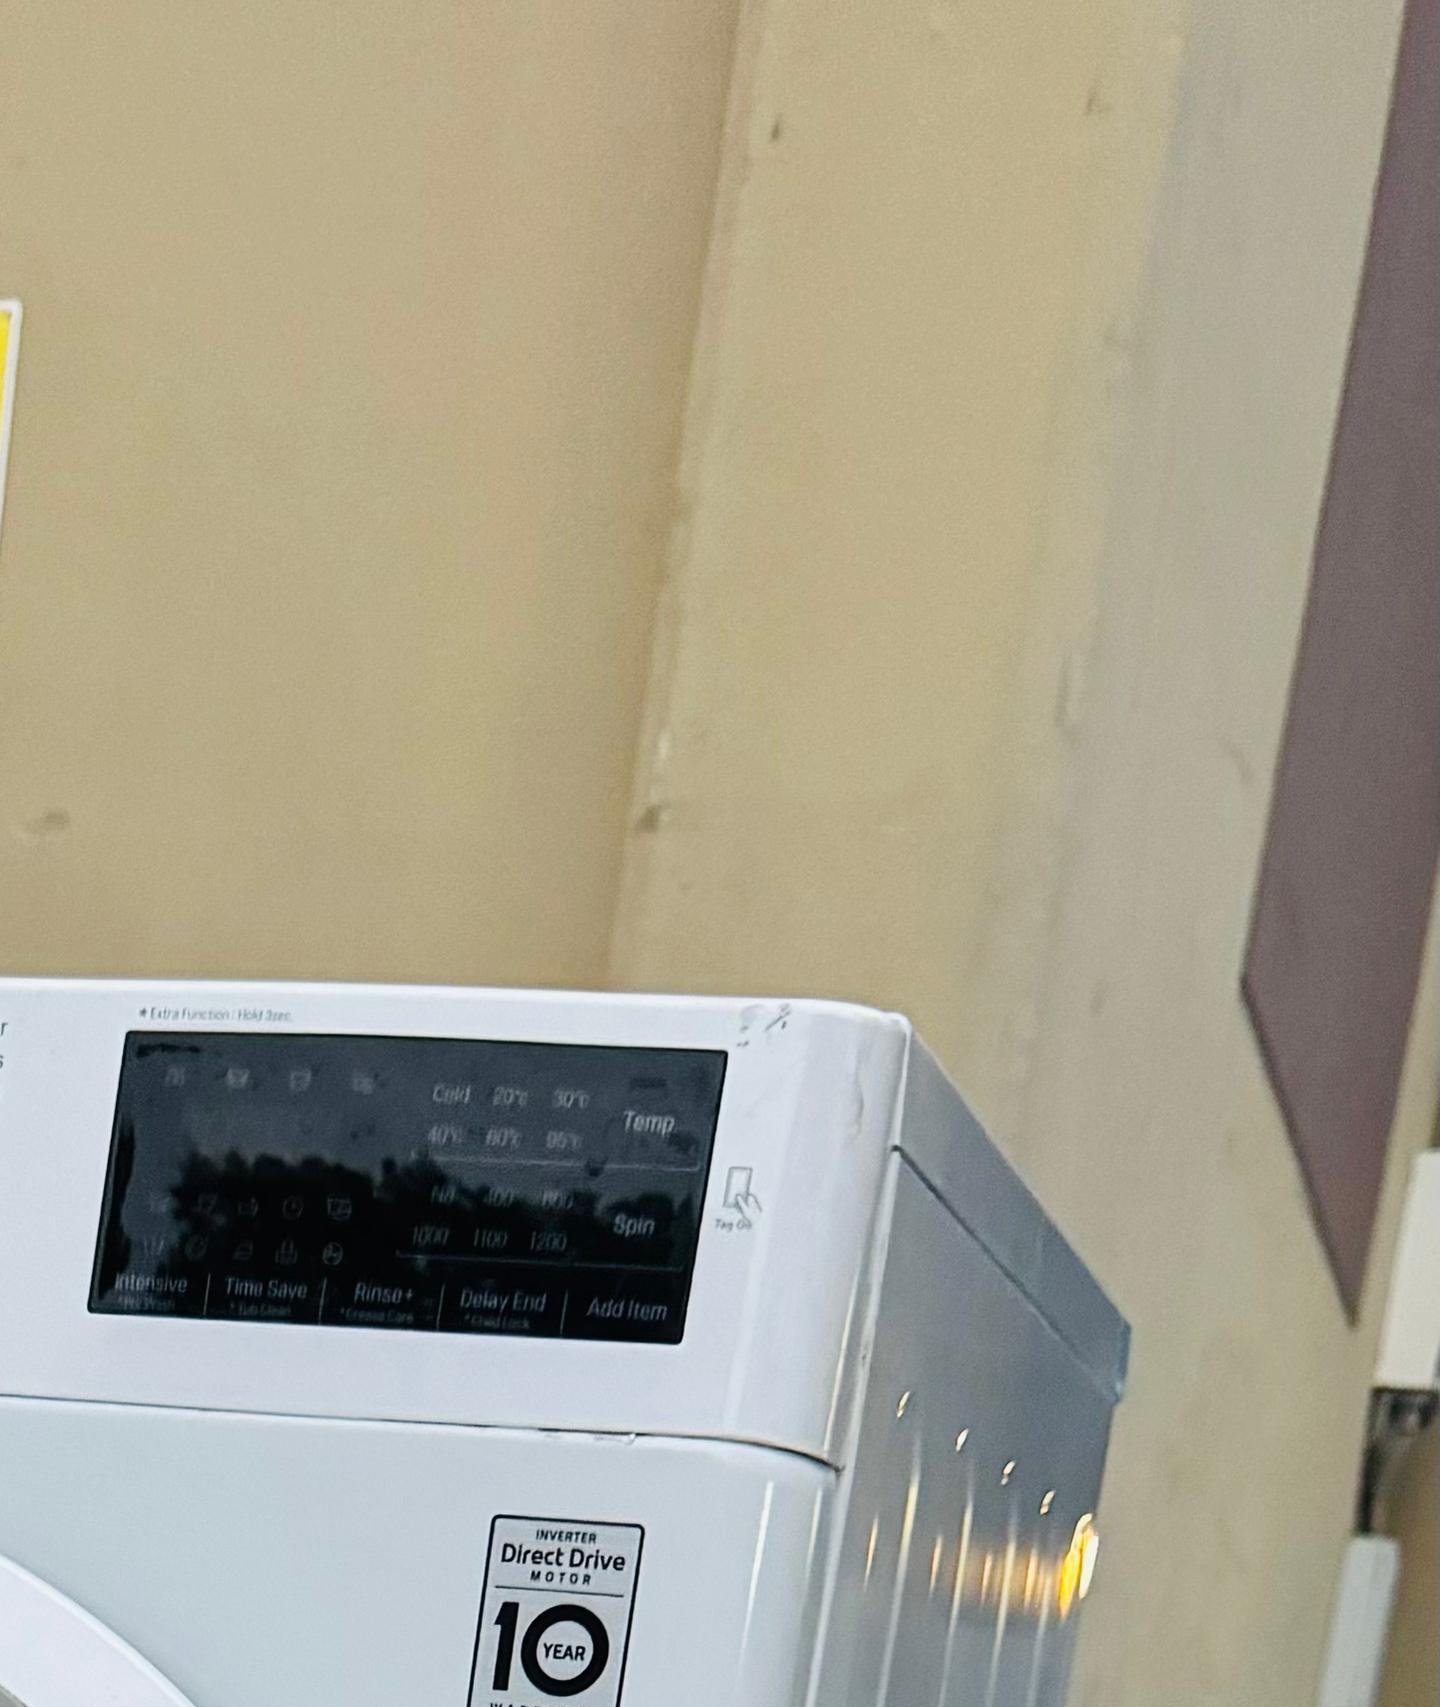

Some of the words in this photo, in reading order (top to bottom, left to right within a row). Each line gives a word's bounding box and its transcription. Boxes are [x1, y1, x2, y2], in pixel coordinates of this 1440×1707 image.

[614, 1213, 656, 1237] Spin
[115, 1271, 188, 1294] Intensive
[224, 1276, 264, 1297] Time
[267, 1279, 308, 1300] Save
[460, 1289, 508, 1314] Delay
[512, 1292, 547, 1313] End
[586, 1296, 624, 1319] Add
[627, 1300, 668, 1321] Item
[536, 1529, 597, 1544] INVERTER
[501, 1543, 563, 1567] Direct
[569, 1548, 626, 1571] Drive
[530, 1570, 592, 1585] MOTOR
[492, 1601, 610, 1697] 10
[543, 1643, 586, 1661] YEAR
